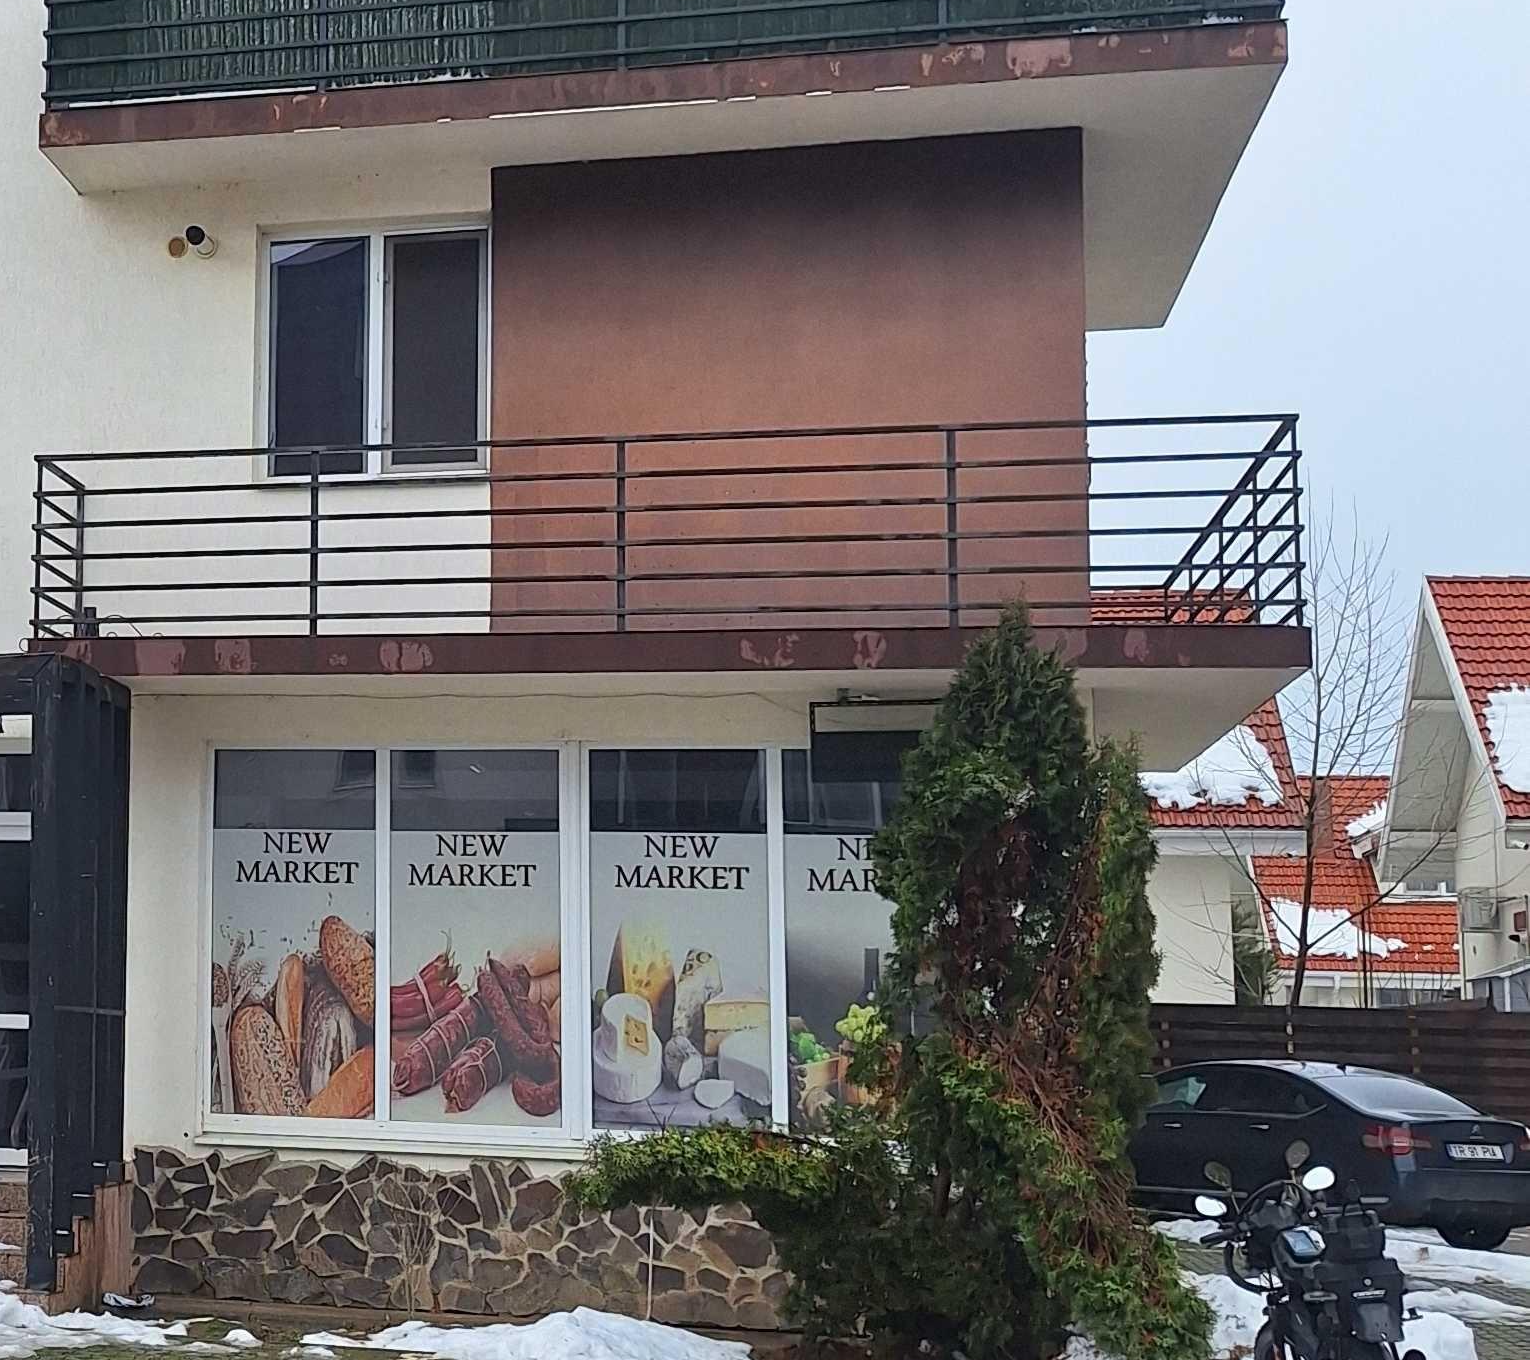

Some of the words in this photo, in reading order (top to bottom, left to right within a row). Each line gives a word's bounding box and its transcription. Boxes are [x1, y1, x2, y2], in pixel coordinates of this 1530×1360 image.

[262, 832, 332, 854] NEW
[436, 834, 509, 857] NEW
[644, 835, 720, 858] NEW
[236, 861, 359, 884] MARKET
[409, 864, 536, 887] MARKET
[615, 865, 749, 889] MARKET
